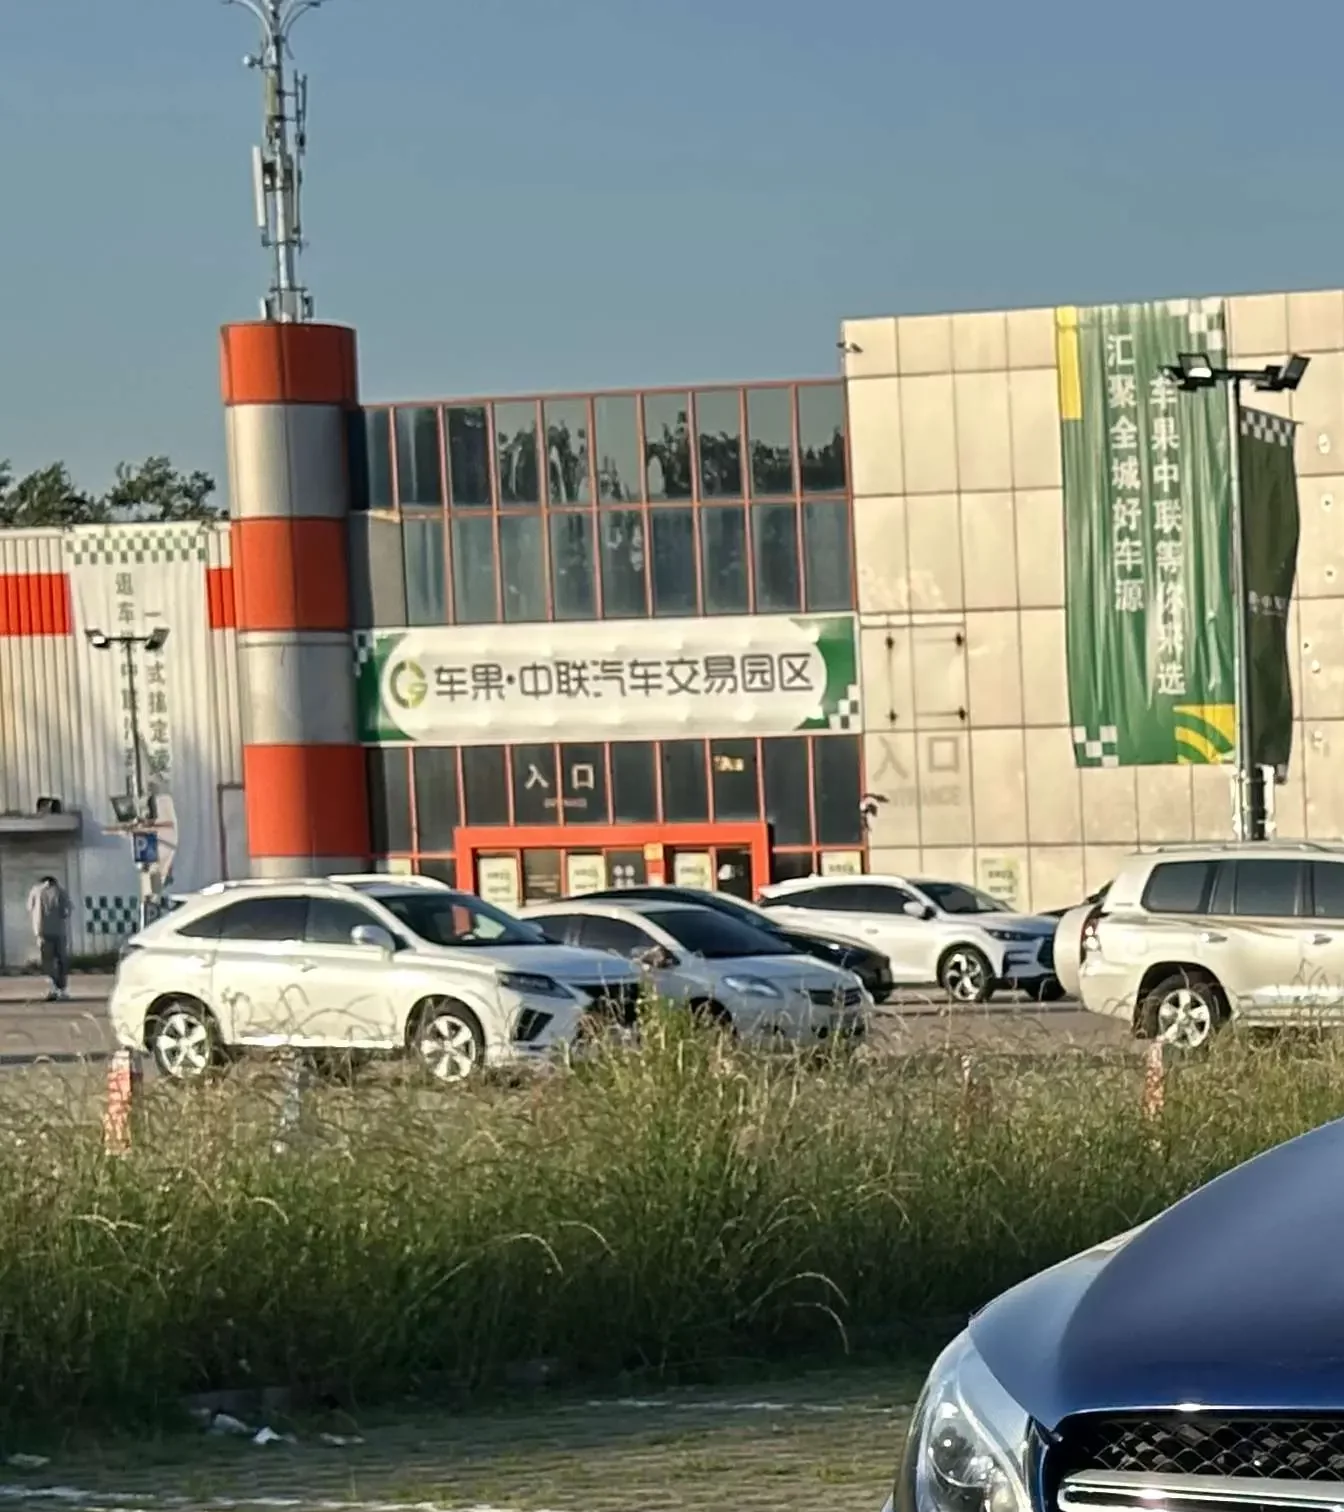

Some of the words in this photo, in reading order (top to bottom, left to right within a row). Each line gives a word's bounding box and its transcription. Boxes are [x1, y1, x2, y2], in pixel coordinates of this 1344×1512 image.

[1106, 333, 1145, 613] 汇聚全城好车源
[434, 652, 814, 702] 车果·中联汽车交易园区
[524, 763, 596, 791] 入口
